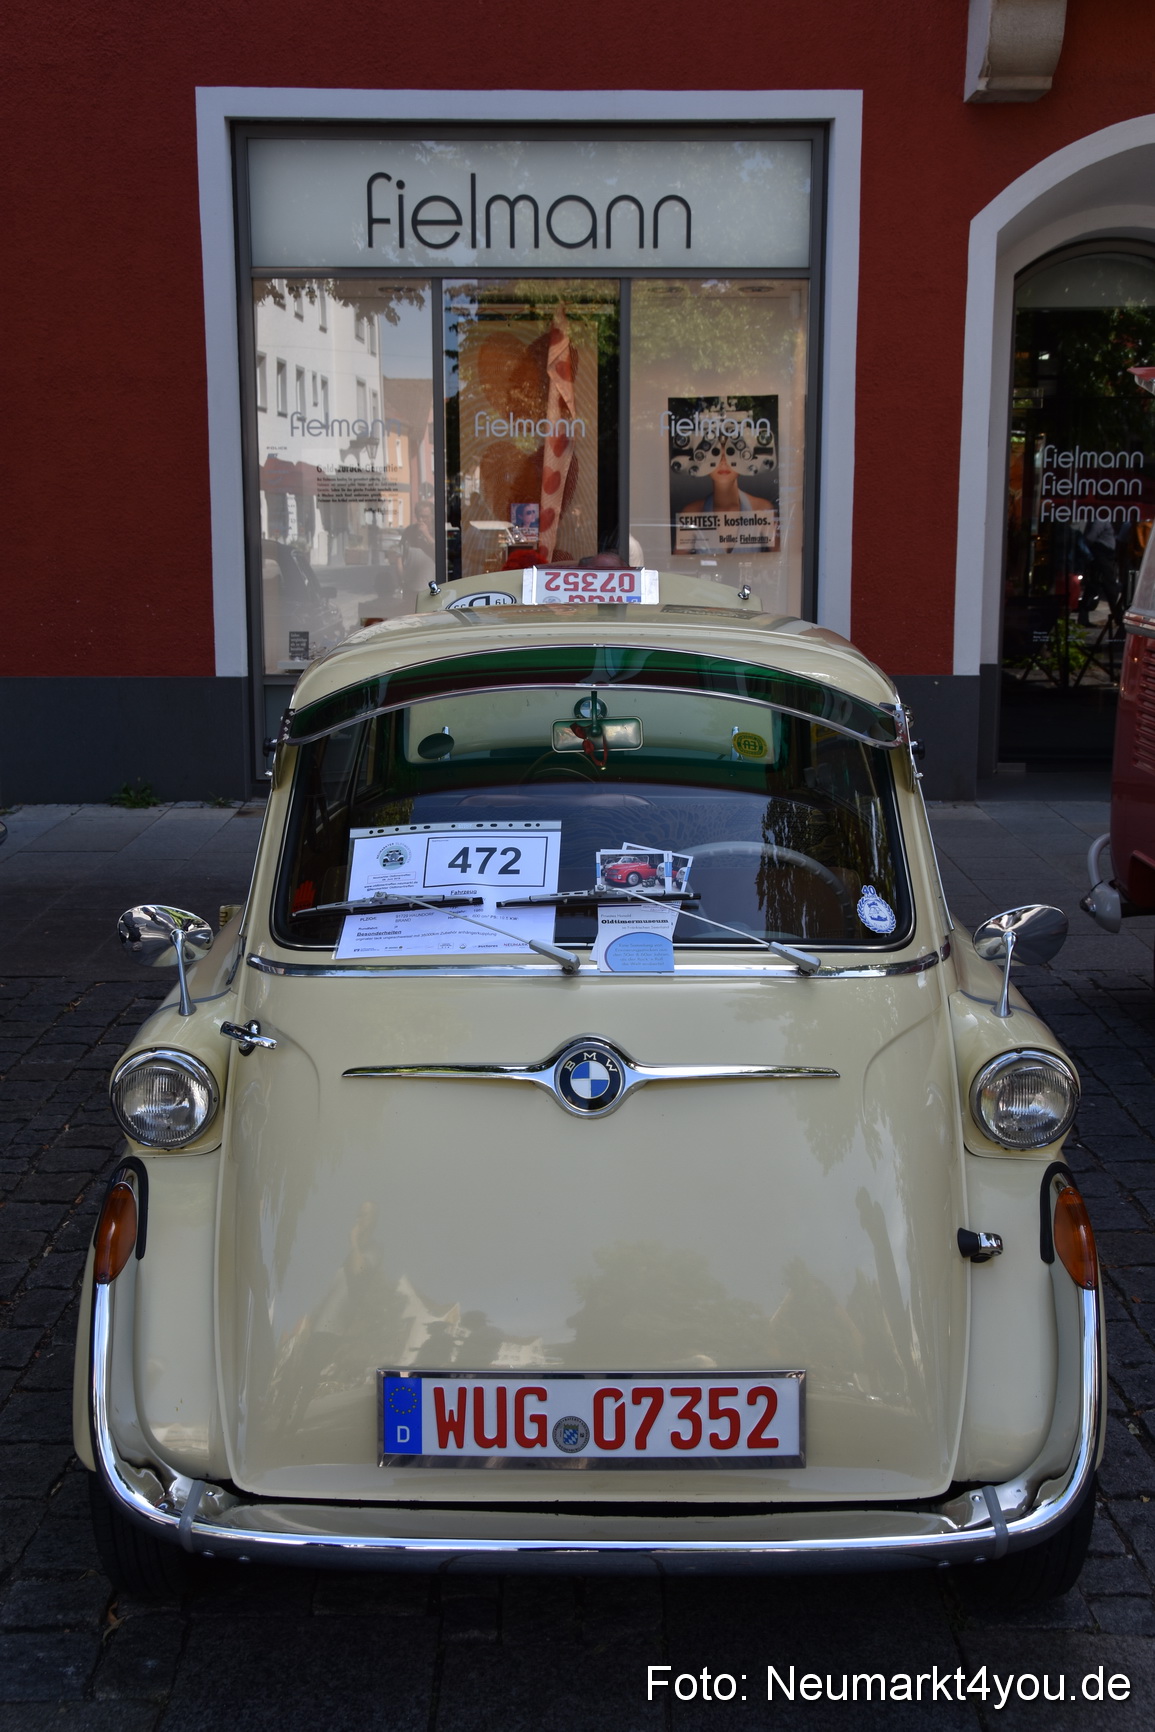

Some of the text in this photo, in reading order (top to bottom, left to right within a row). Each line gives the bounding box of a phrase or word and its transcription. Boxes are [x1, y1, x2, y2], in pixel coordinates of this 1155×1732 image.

[724, 514, 771, 527] kostenlos.
[719, 534, 738, 543] Brille:
[740, 534, 772, 544] Fielmann.
[544, 571, 636, 593] 07352
[447, 846, 522, 875] 472
[565, 1052, 618, 1072] BMW
[432, 1385, 548, 1450] WUG
[592, 1385, 780, 1451] 07352
[396, 1425, 411, 1444] D
